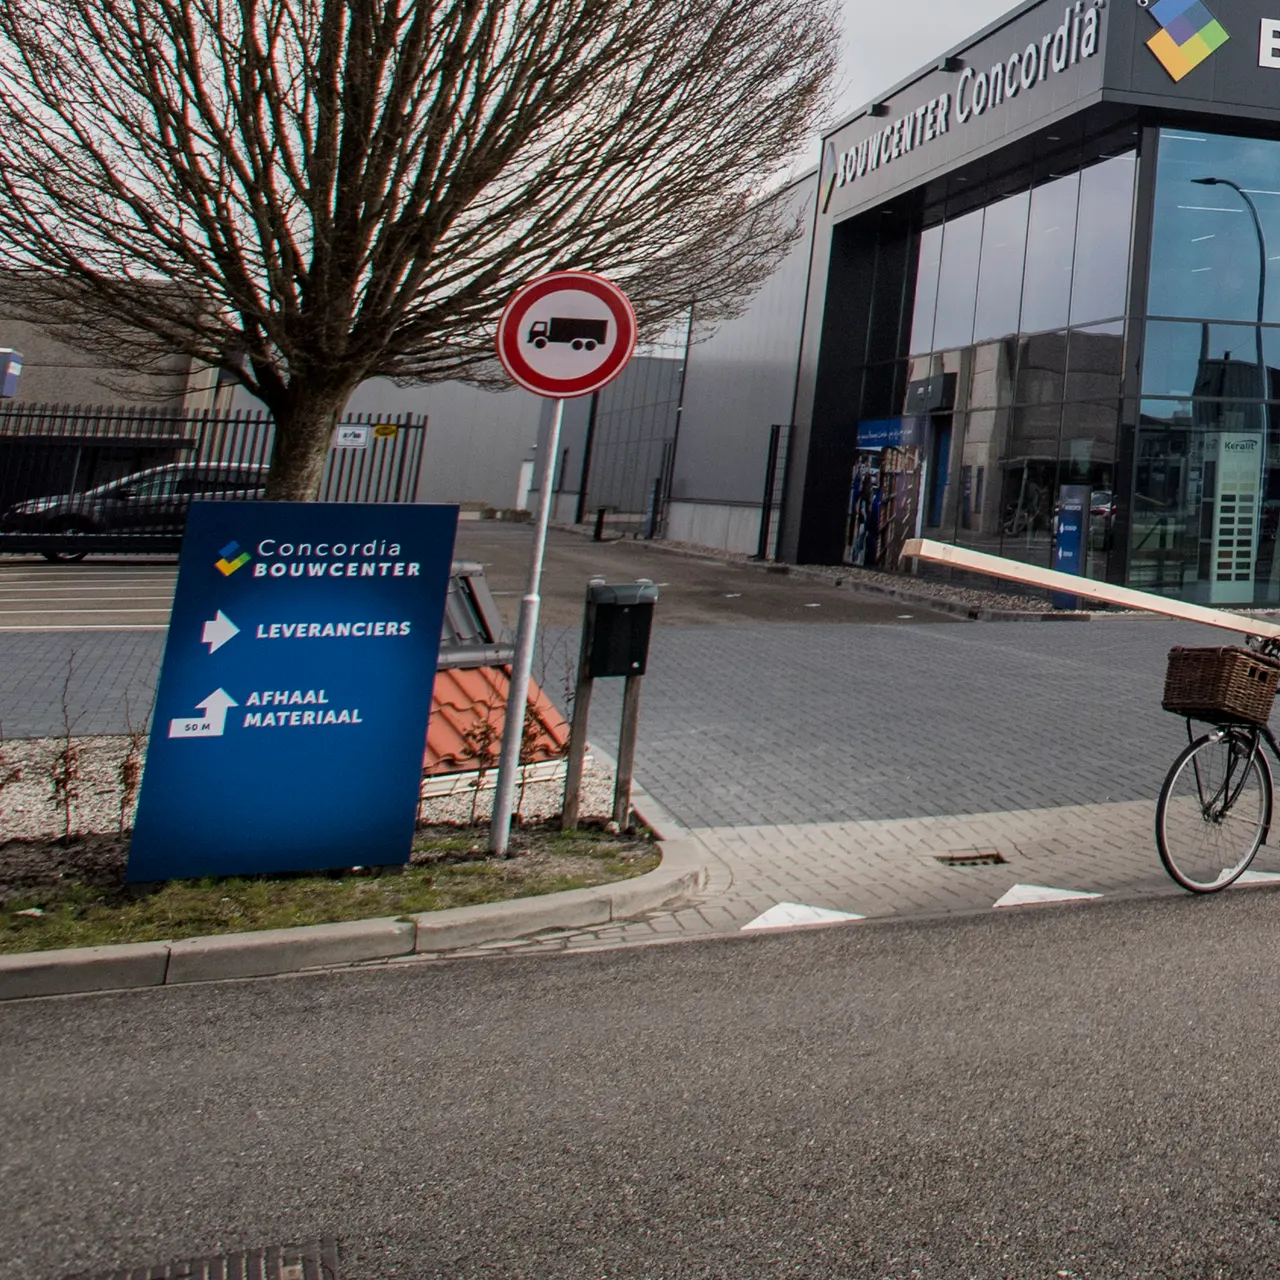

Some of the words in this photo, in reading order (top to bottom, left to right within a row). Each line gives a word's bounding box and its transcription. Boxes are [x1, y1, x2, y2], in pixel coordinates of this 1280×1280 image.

[836, 92, 950, 188] BOUWCENTER
[956, 0, 1100, 124] Concordia
[257, 539, 402, 557] Concordia
[253, 562, 421, 578] BOUWCENTER
[256, 621, 412, 639] LEVERANCIERS
[245, 689, 329, 707] AFHAAL
[184, 722, 199, 732] 50
[200, 722, 211, 731] M
[243, 708, 363, 728] MATERIAAL
